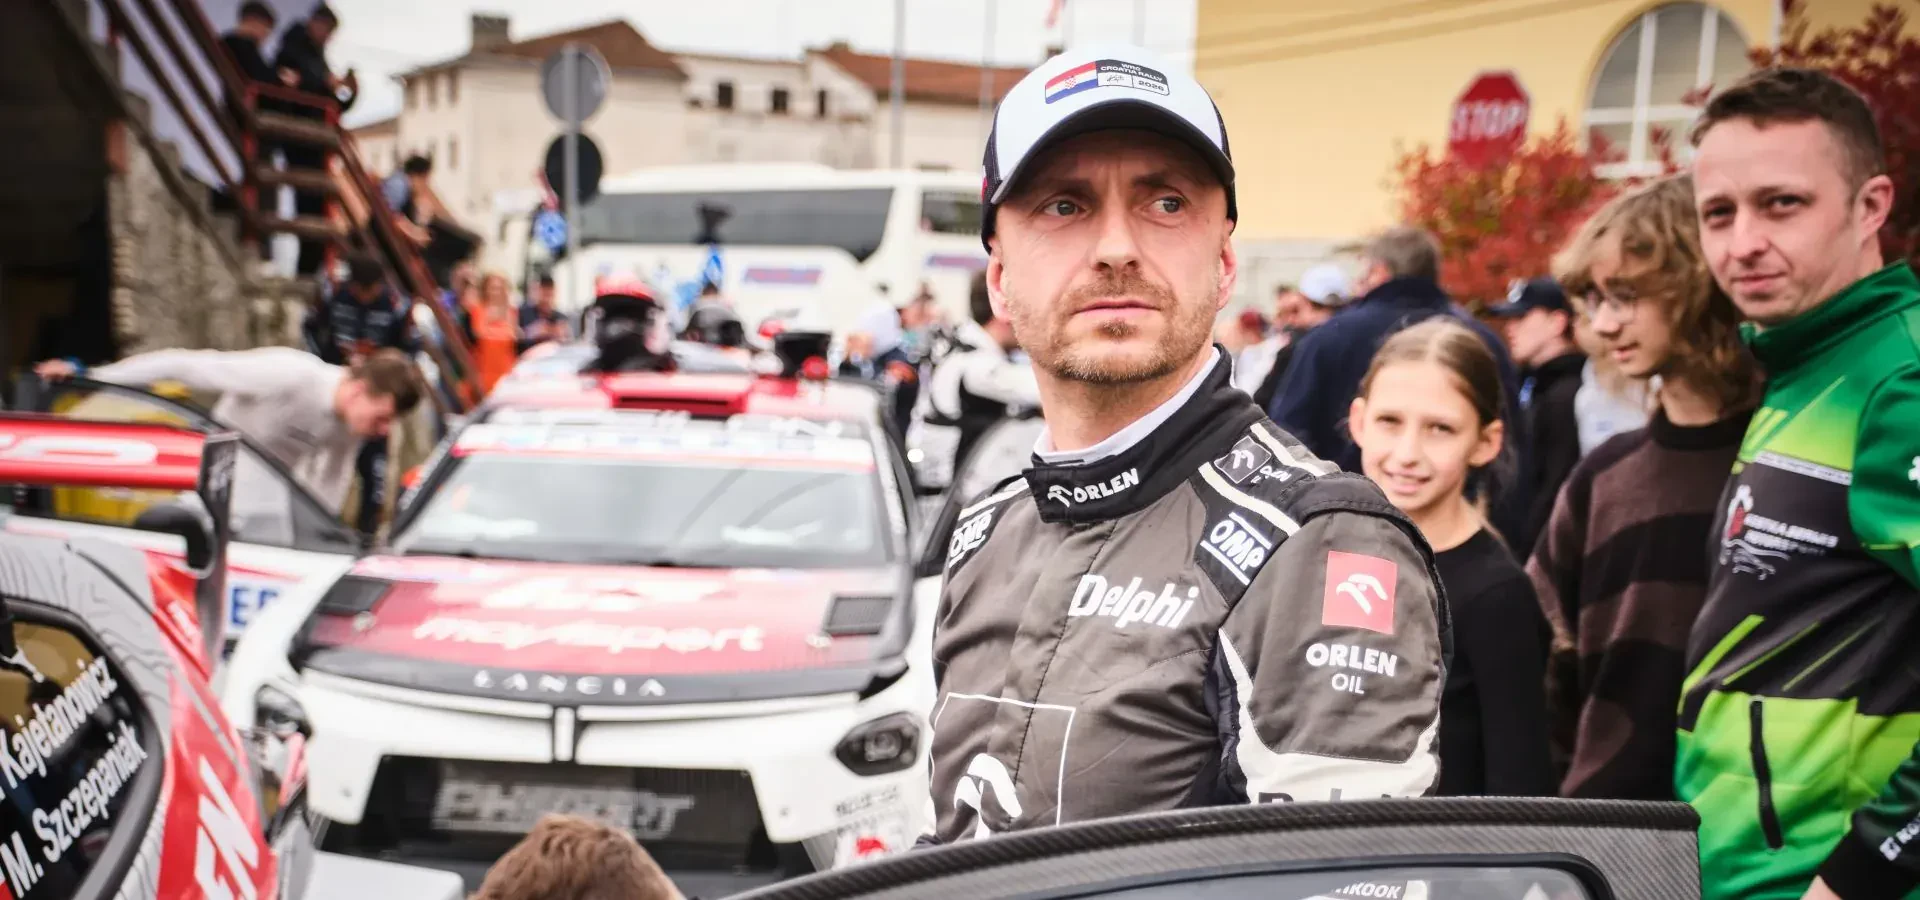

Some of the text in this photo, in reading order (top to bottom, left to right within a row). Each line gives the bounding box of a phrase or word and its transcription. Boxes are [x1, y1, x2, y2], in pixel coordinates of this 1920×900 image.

[1100, 65, 1163, 82] CROATIA RALLY
[1121, 63, 1141, 72] WRC
[1450, 101, 1528, 140] STOP
[1073, 467, 1139, 503] ORLEN
[1209, 519, 1265, 572] OMP
[1067, 573, 1200, 630] Delphi
[1305, 642, 1398, 678] ORLEN
[473, 669, 667, 697] LANCIA
[1331, 673, 1366, 695] OIL
[0, 655, 118, 789] Kajetanowicz
[1, 719, 148, 899] M. Szczepaniak
